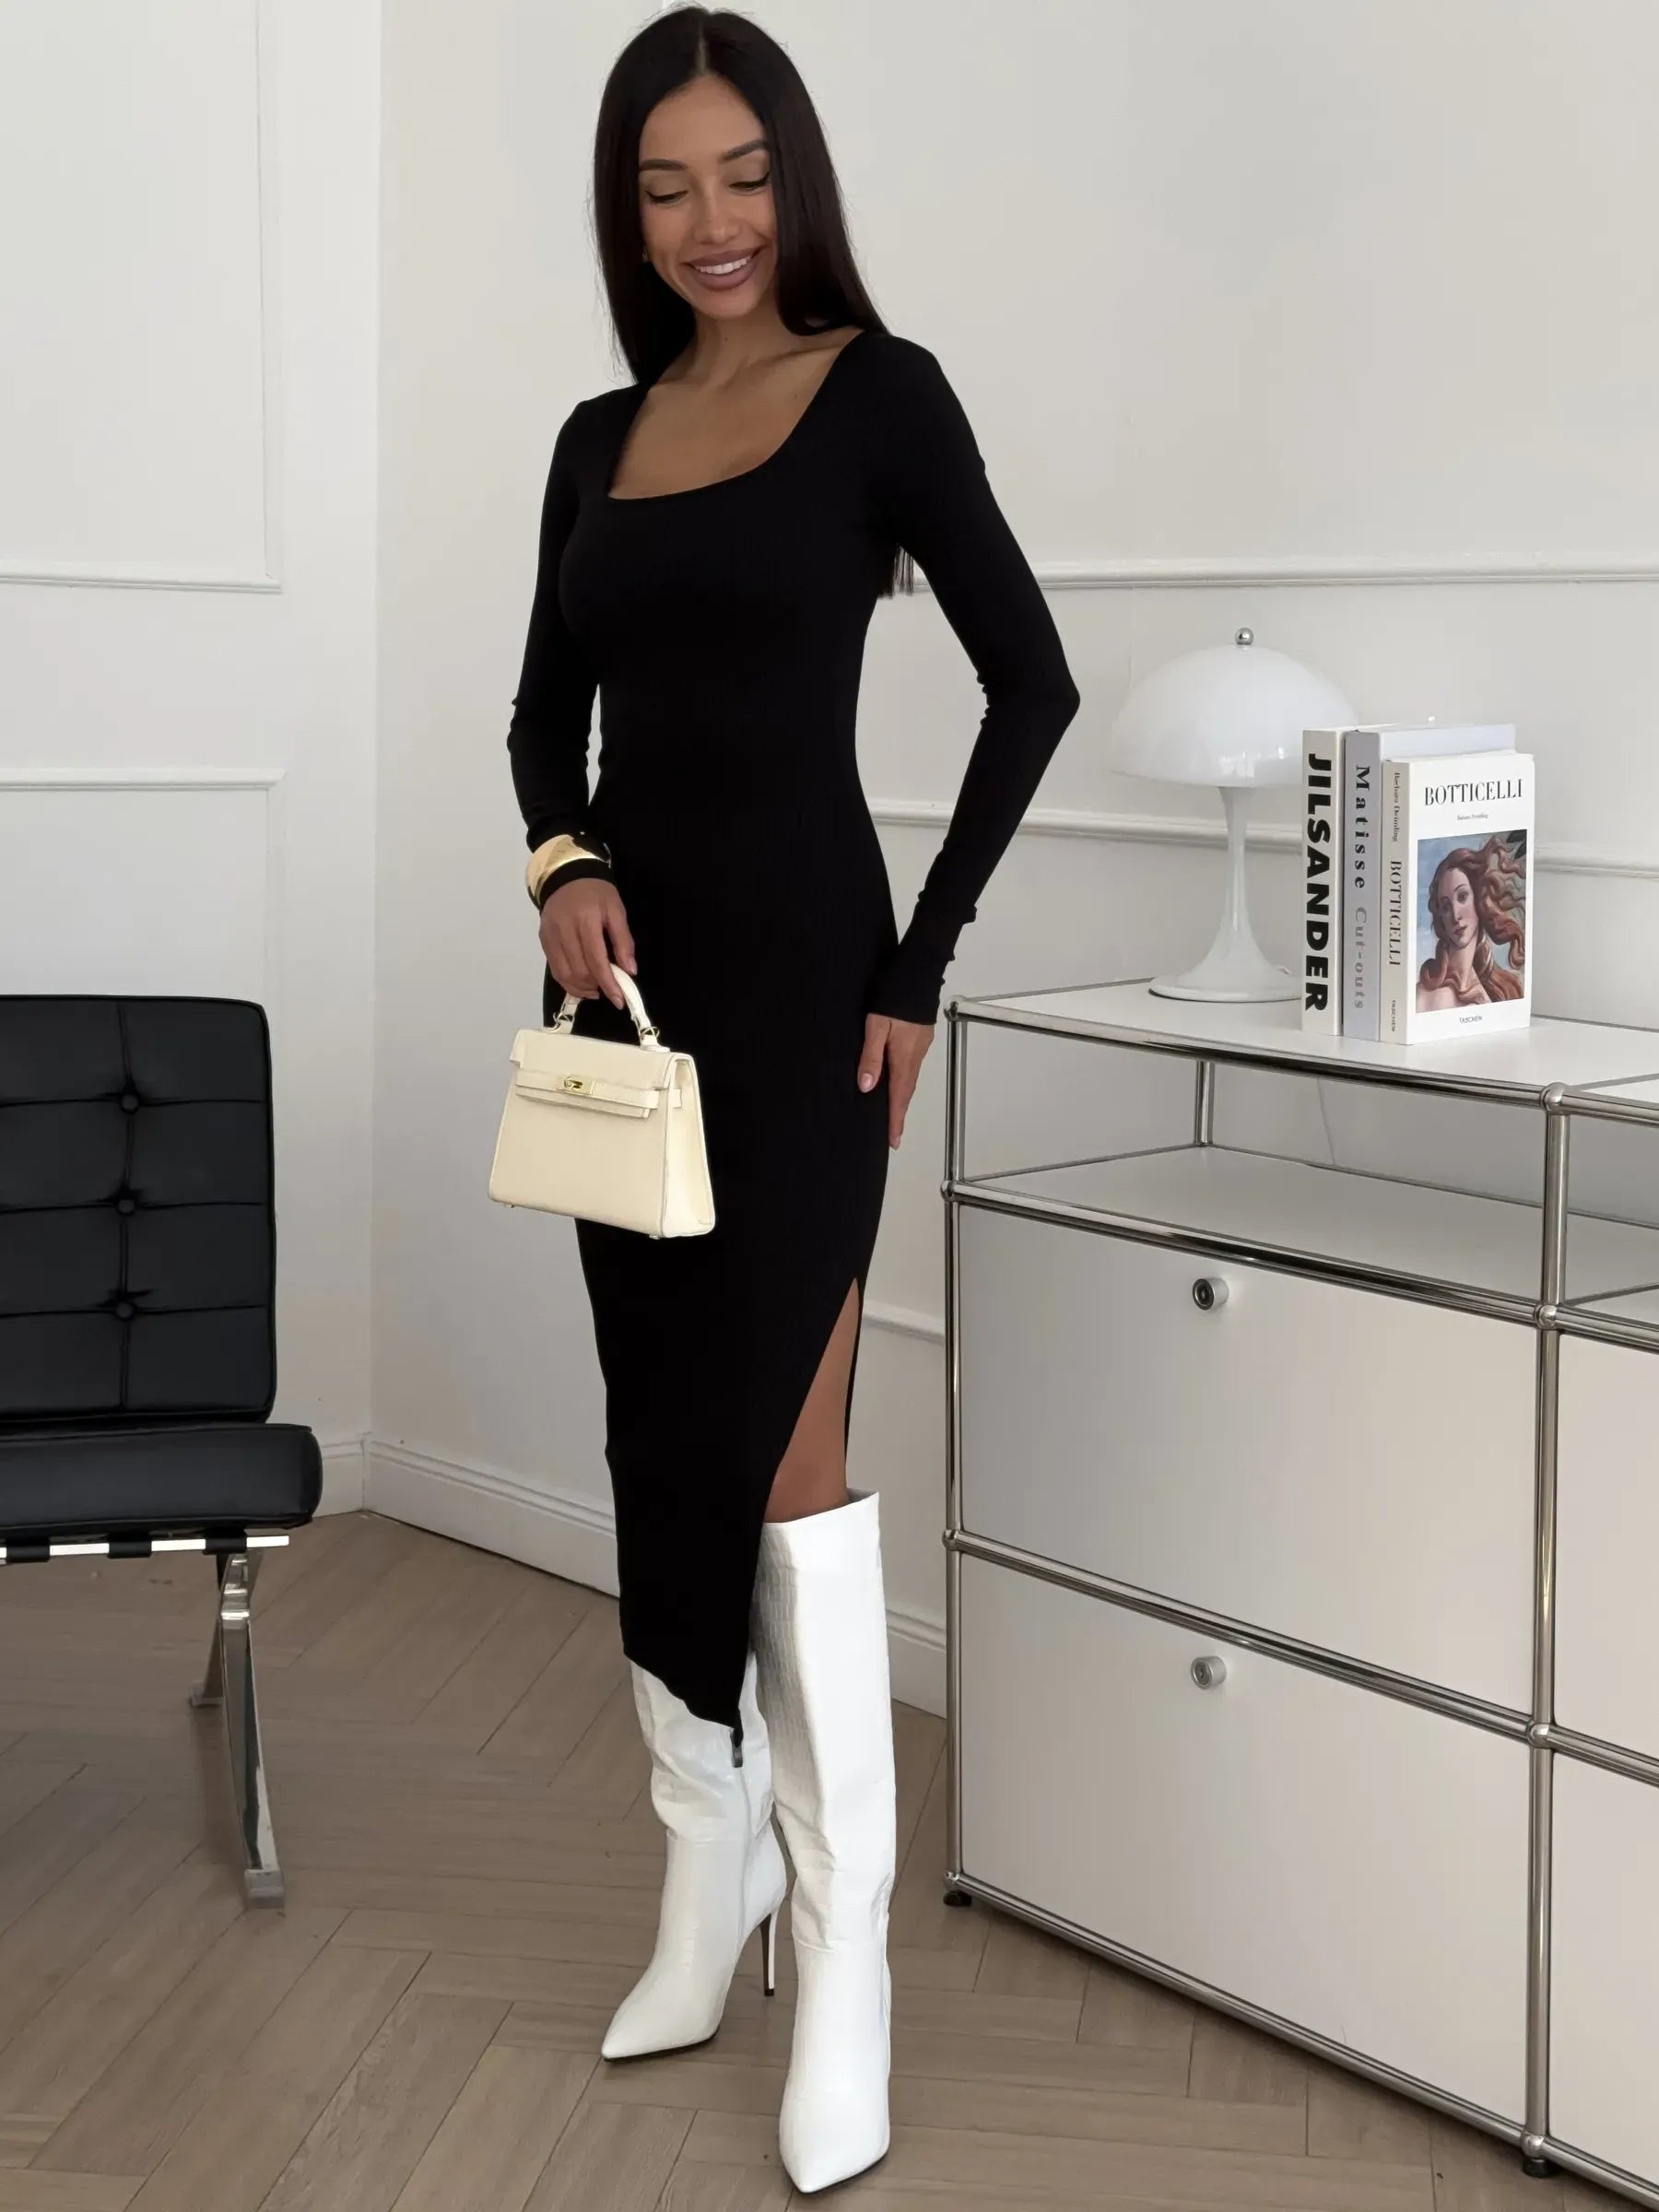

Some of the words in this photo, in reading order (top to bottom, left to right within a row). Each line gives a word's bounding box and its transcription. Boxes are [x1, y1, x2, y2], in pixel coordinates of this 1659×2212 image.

[1354, 765, 1371, 888] Matisse
[1424, 779, 1523, 806] BOTTICELLI
[1354, 906, 1367, 1009] Cut-outs
[1389, 861, 1402, 966] BOTTICELLI
[1459, 1015, 1483, 1024] TASCHEN
